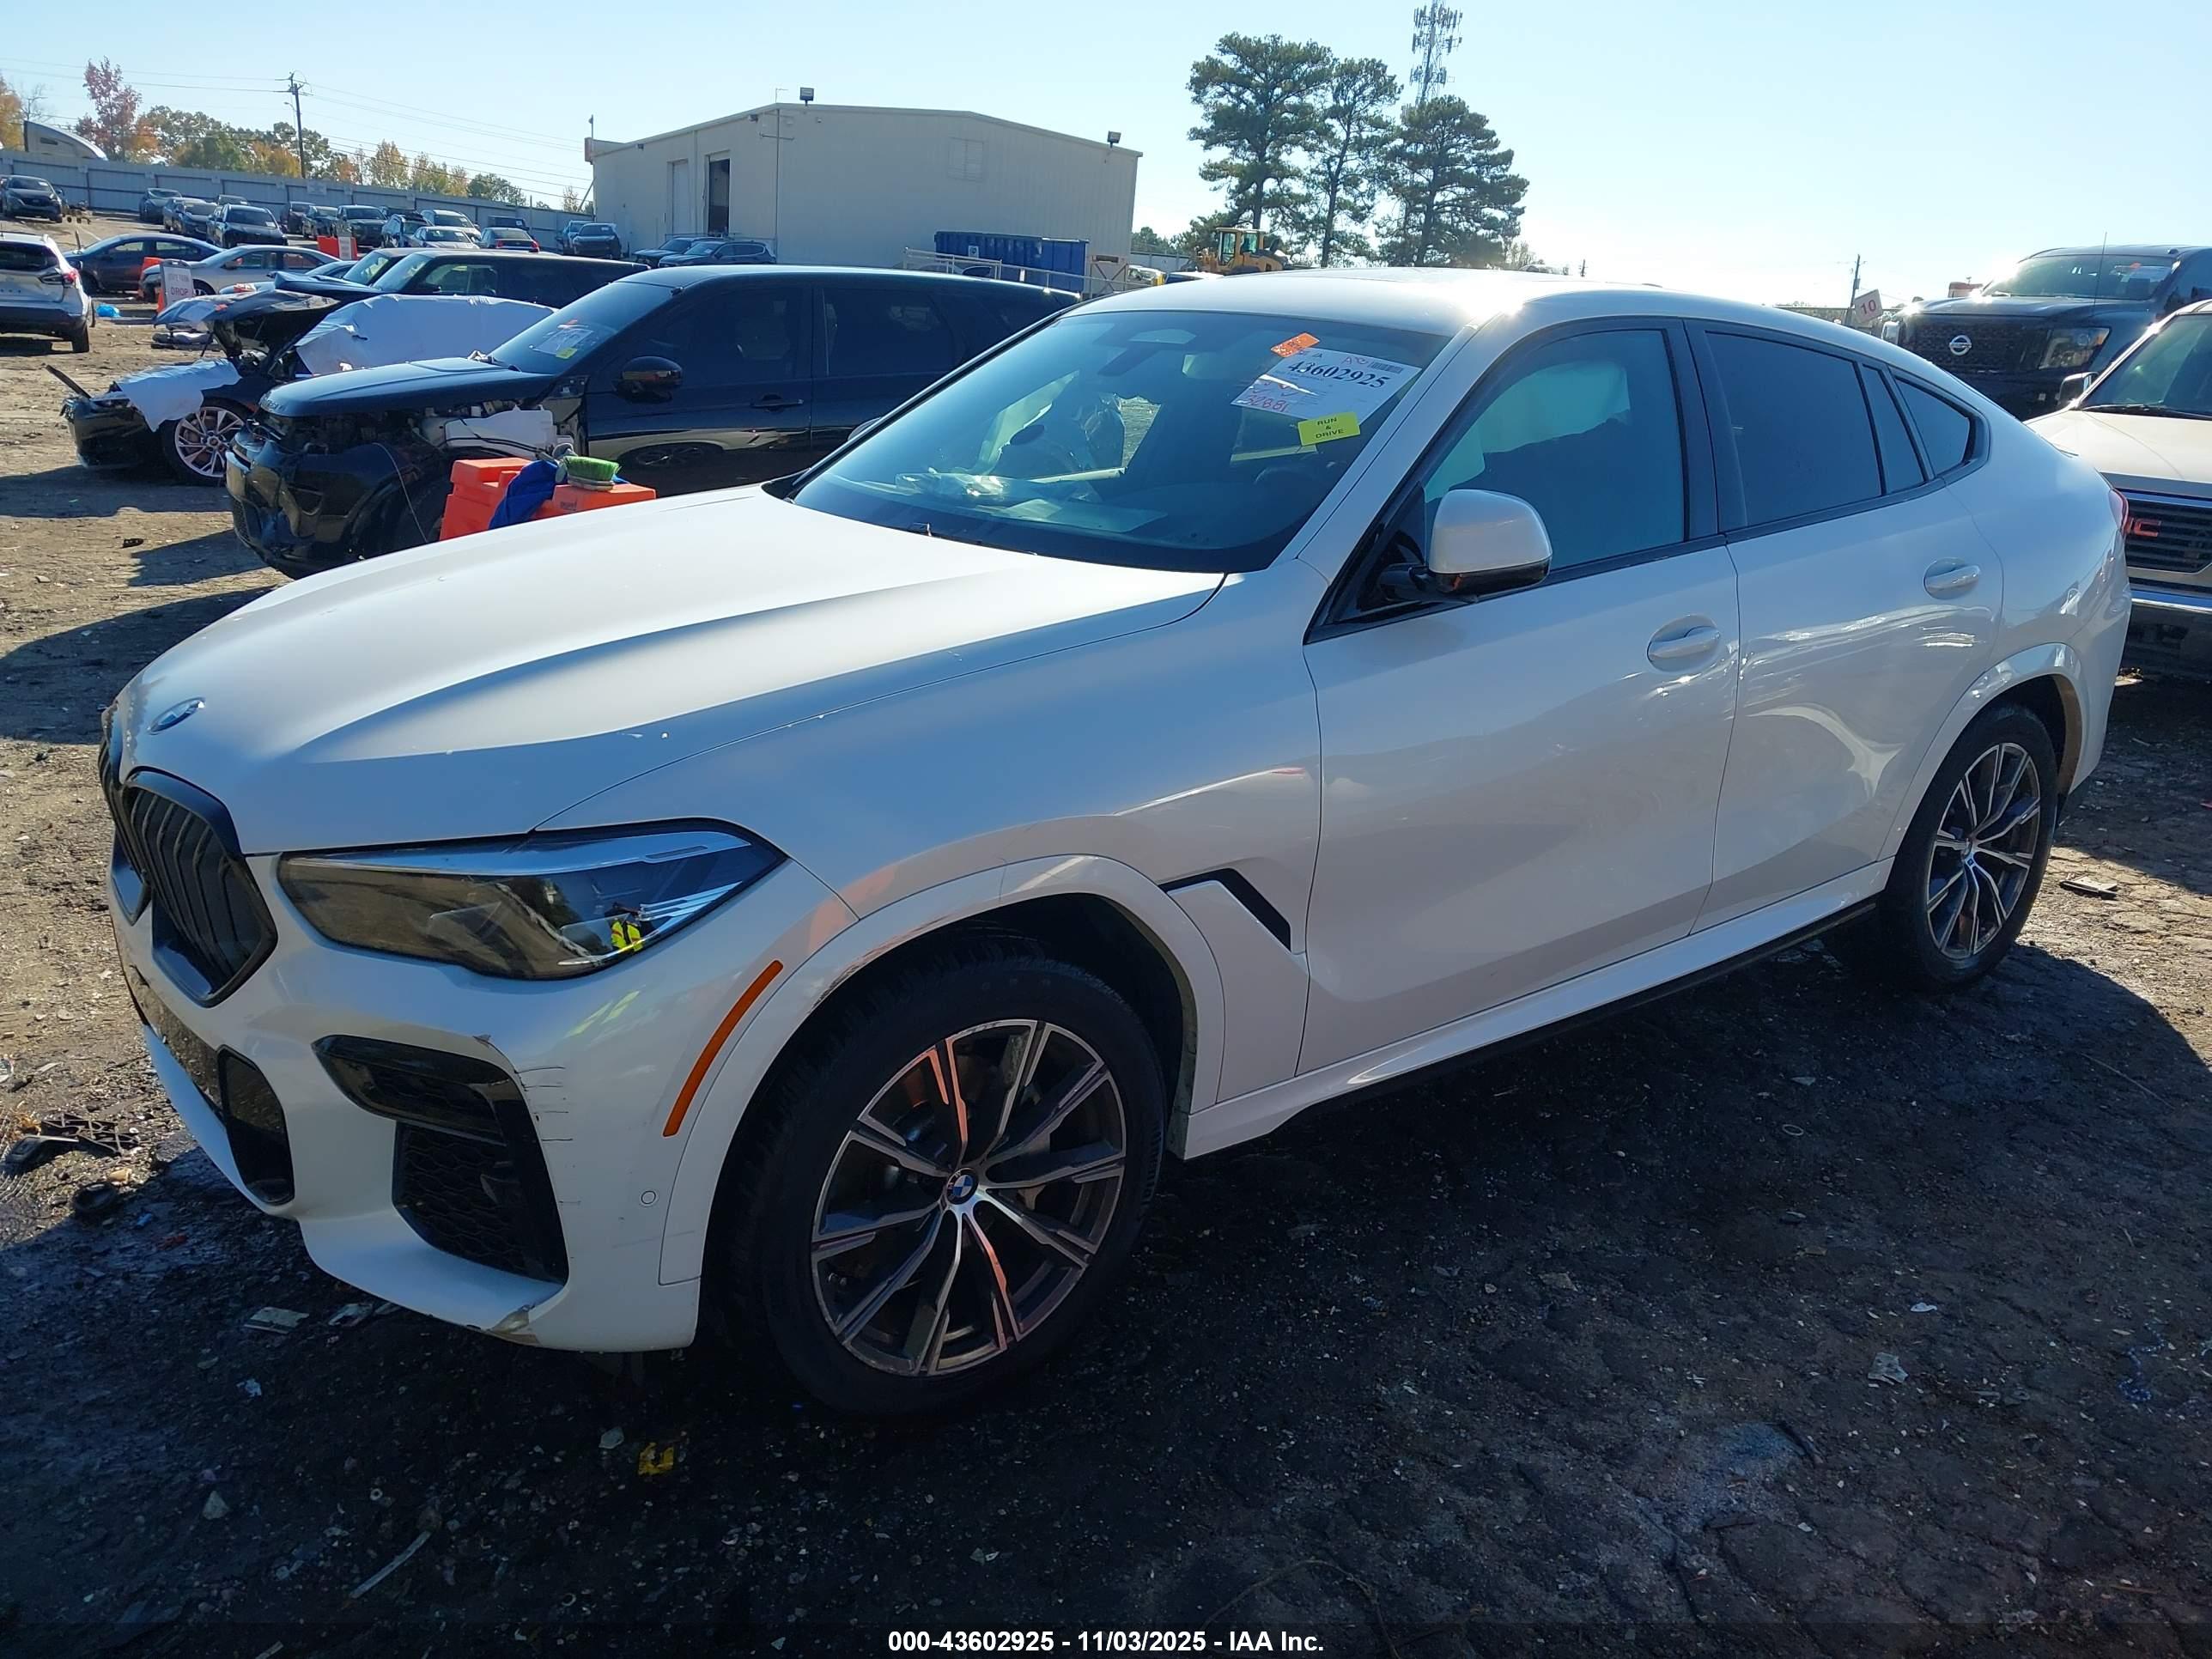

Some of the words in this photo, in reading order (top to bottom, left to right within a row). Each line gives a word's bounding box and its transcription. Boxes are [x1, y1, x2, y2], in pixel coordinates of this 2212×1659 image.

[1861, 300, 1876, 315] 10
[1288, 361, 1391, 388] 43602925
[1317, 416, 1337, 426] RUN
[1316, 428, 1346, 439] DRIVE
